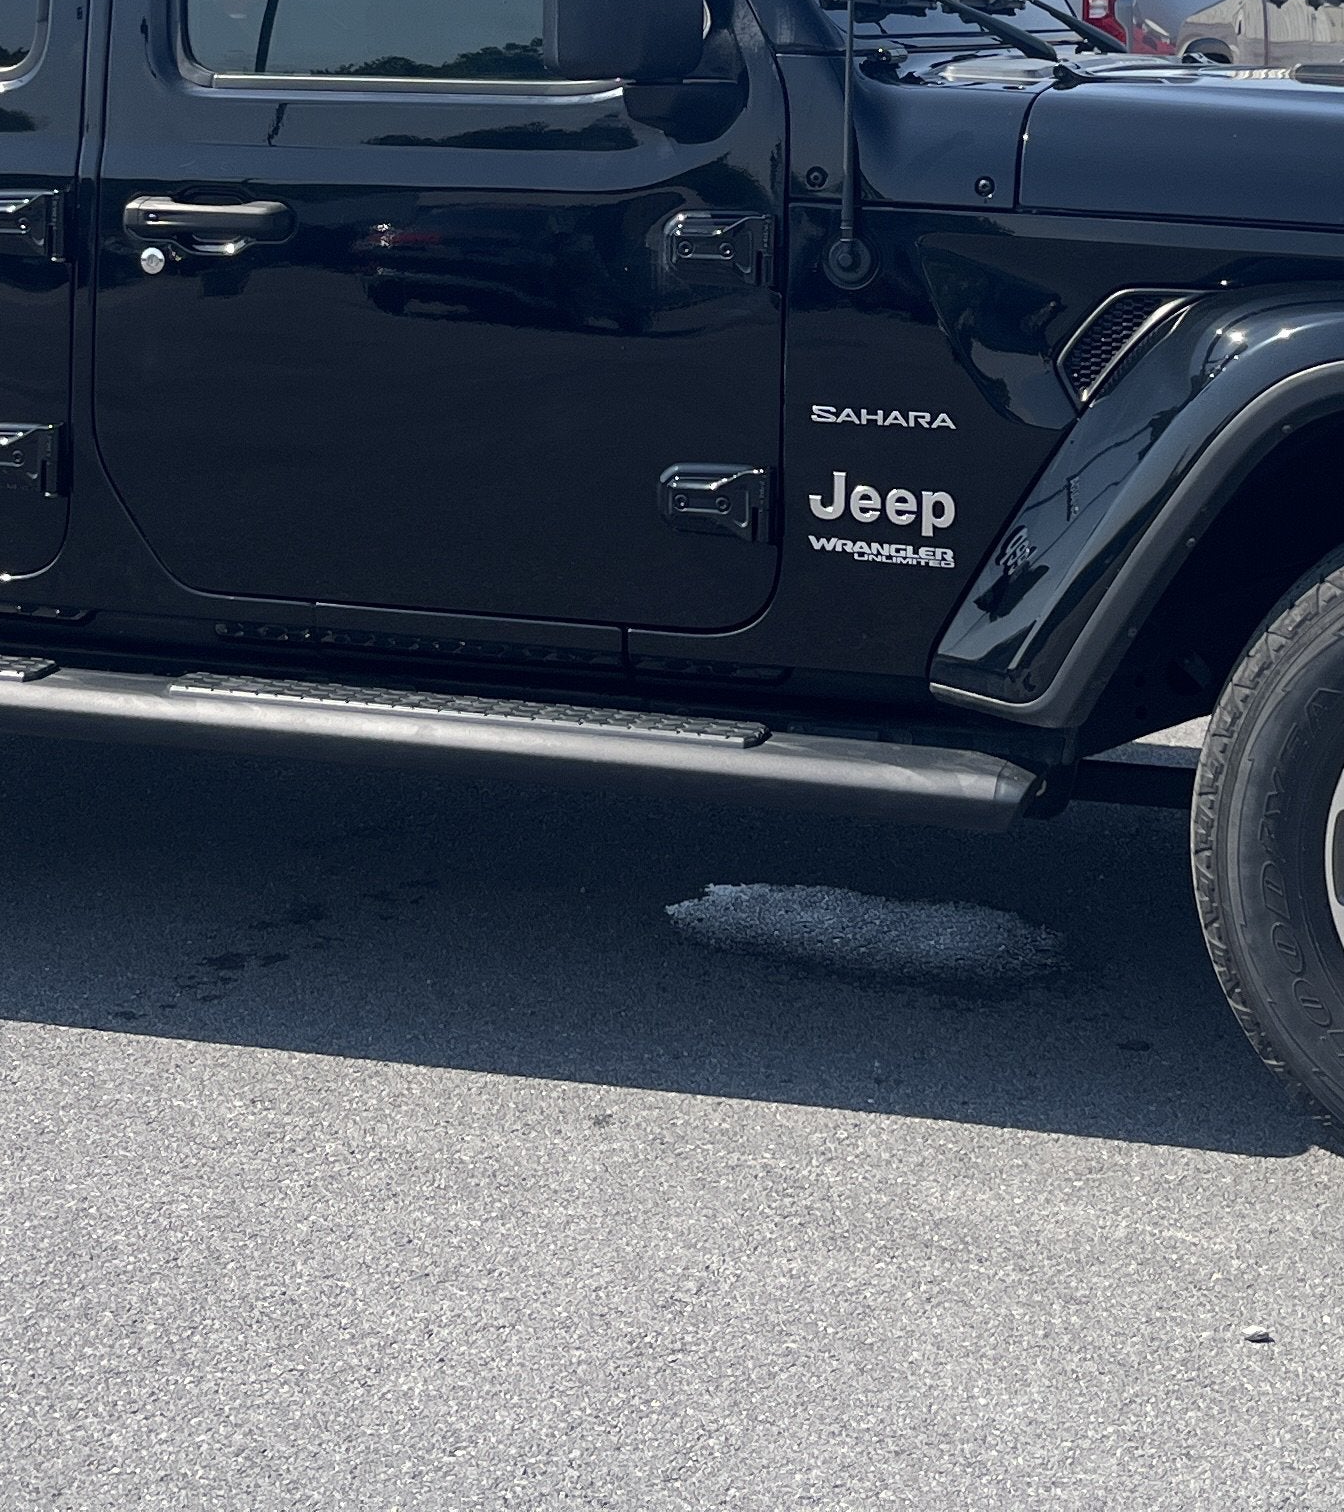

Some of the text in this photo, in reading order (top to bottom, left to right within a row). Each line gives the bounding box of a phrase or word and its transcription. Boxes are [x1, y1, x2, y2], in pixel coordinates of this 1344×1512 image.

[810, 404, 956, 429] SAHARA
[808, 470, 956, 537] Jeep
[807, 535, 955, 560] WRANGLER
[853, 551, 955, 569] UNLIMITED
